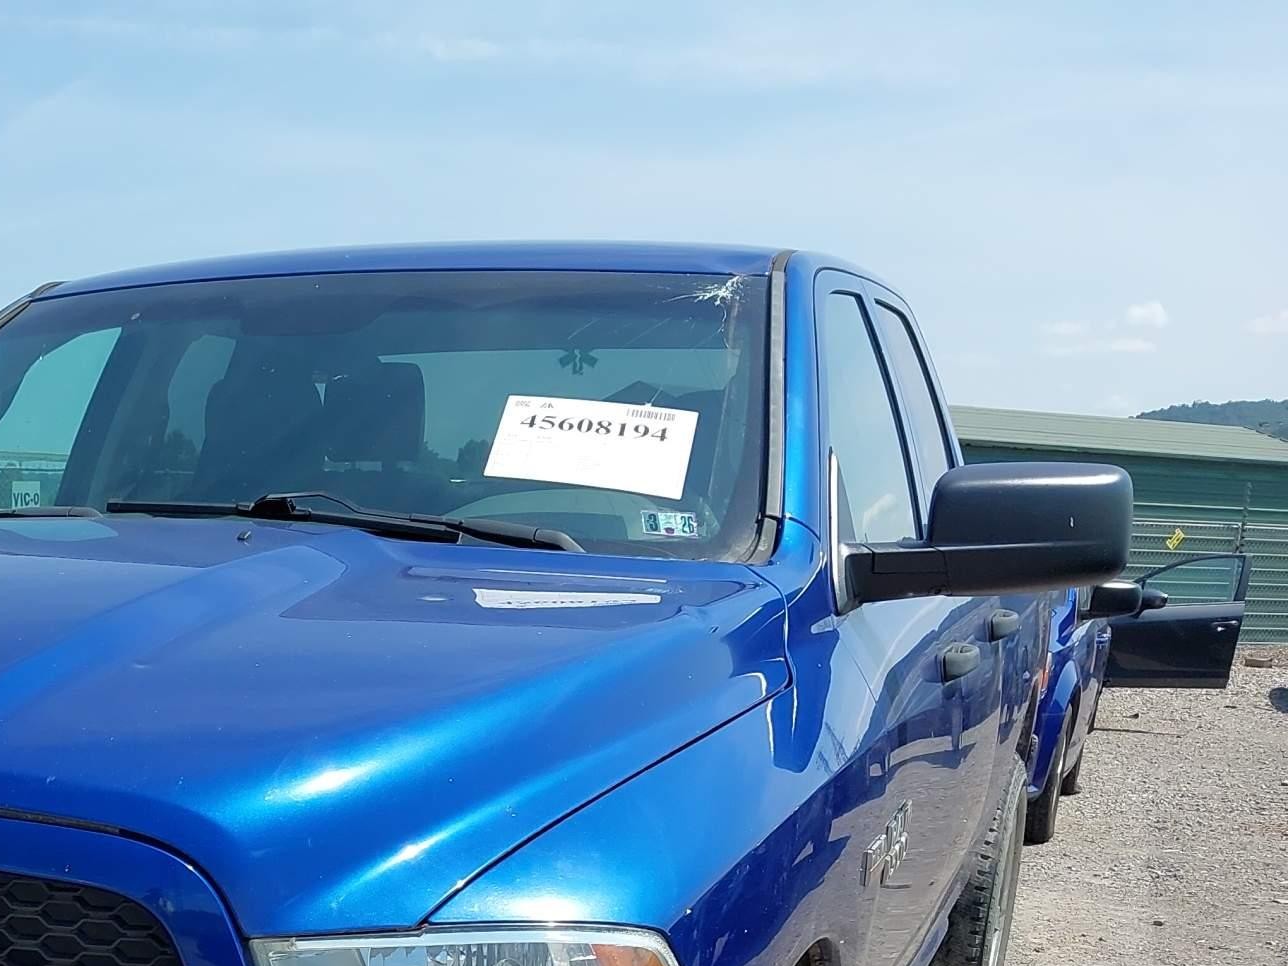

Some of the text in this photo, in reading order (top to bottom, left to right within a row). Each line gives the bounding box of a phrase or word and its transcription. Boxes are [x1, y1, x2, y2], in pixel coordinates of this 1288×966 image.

[520, 404, 668, 442] 45608194
[647, 513, 658, 531] 3
[681, 515, 695, 533] 26
